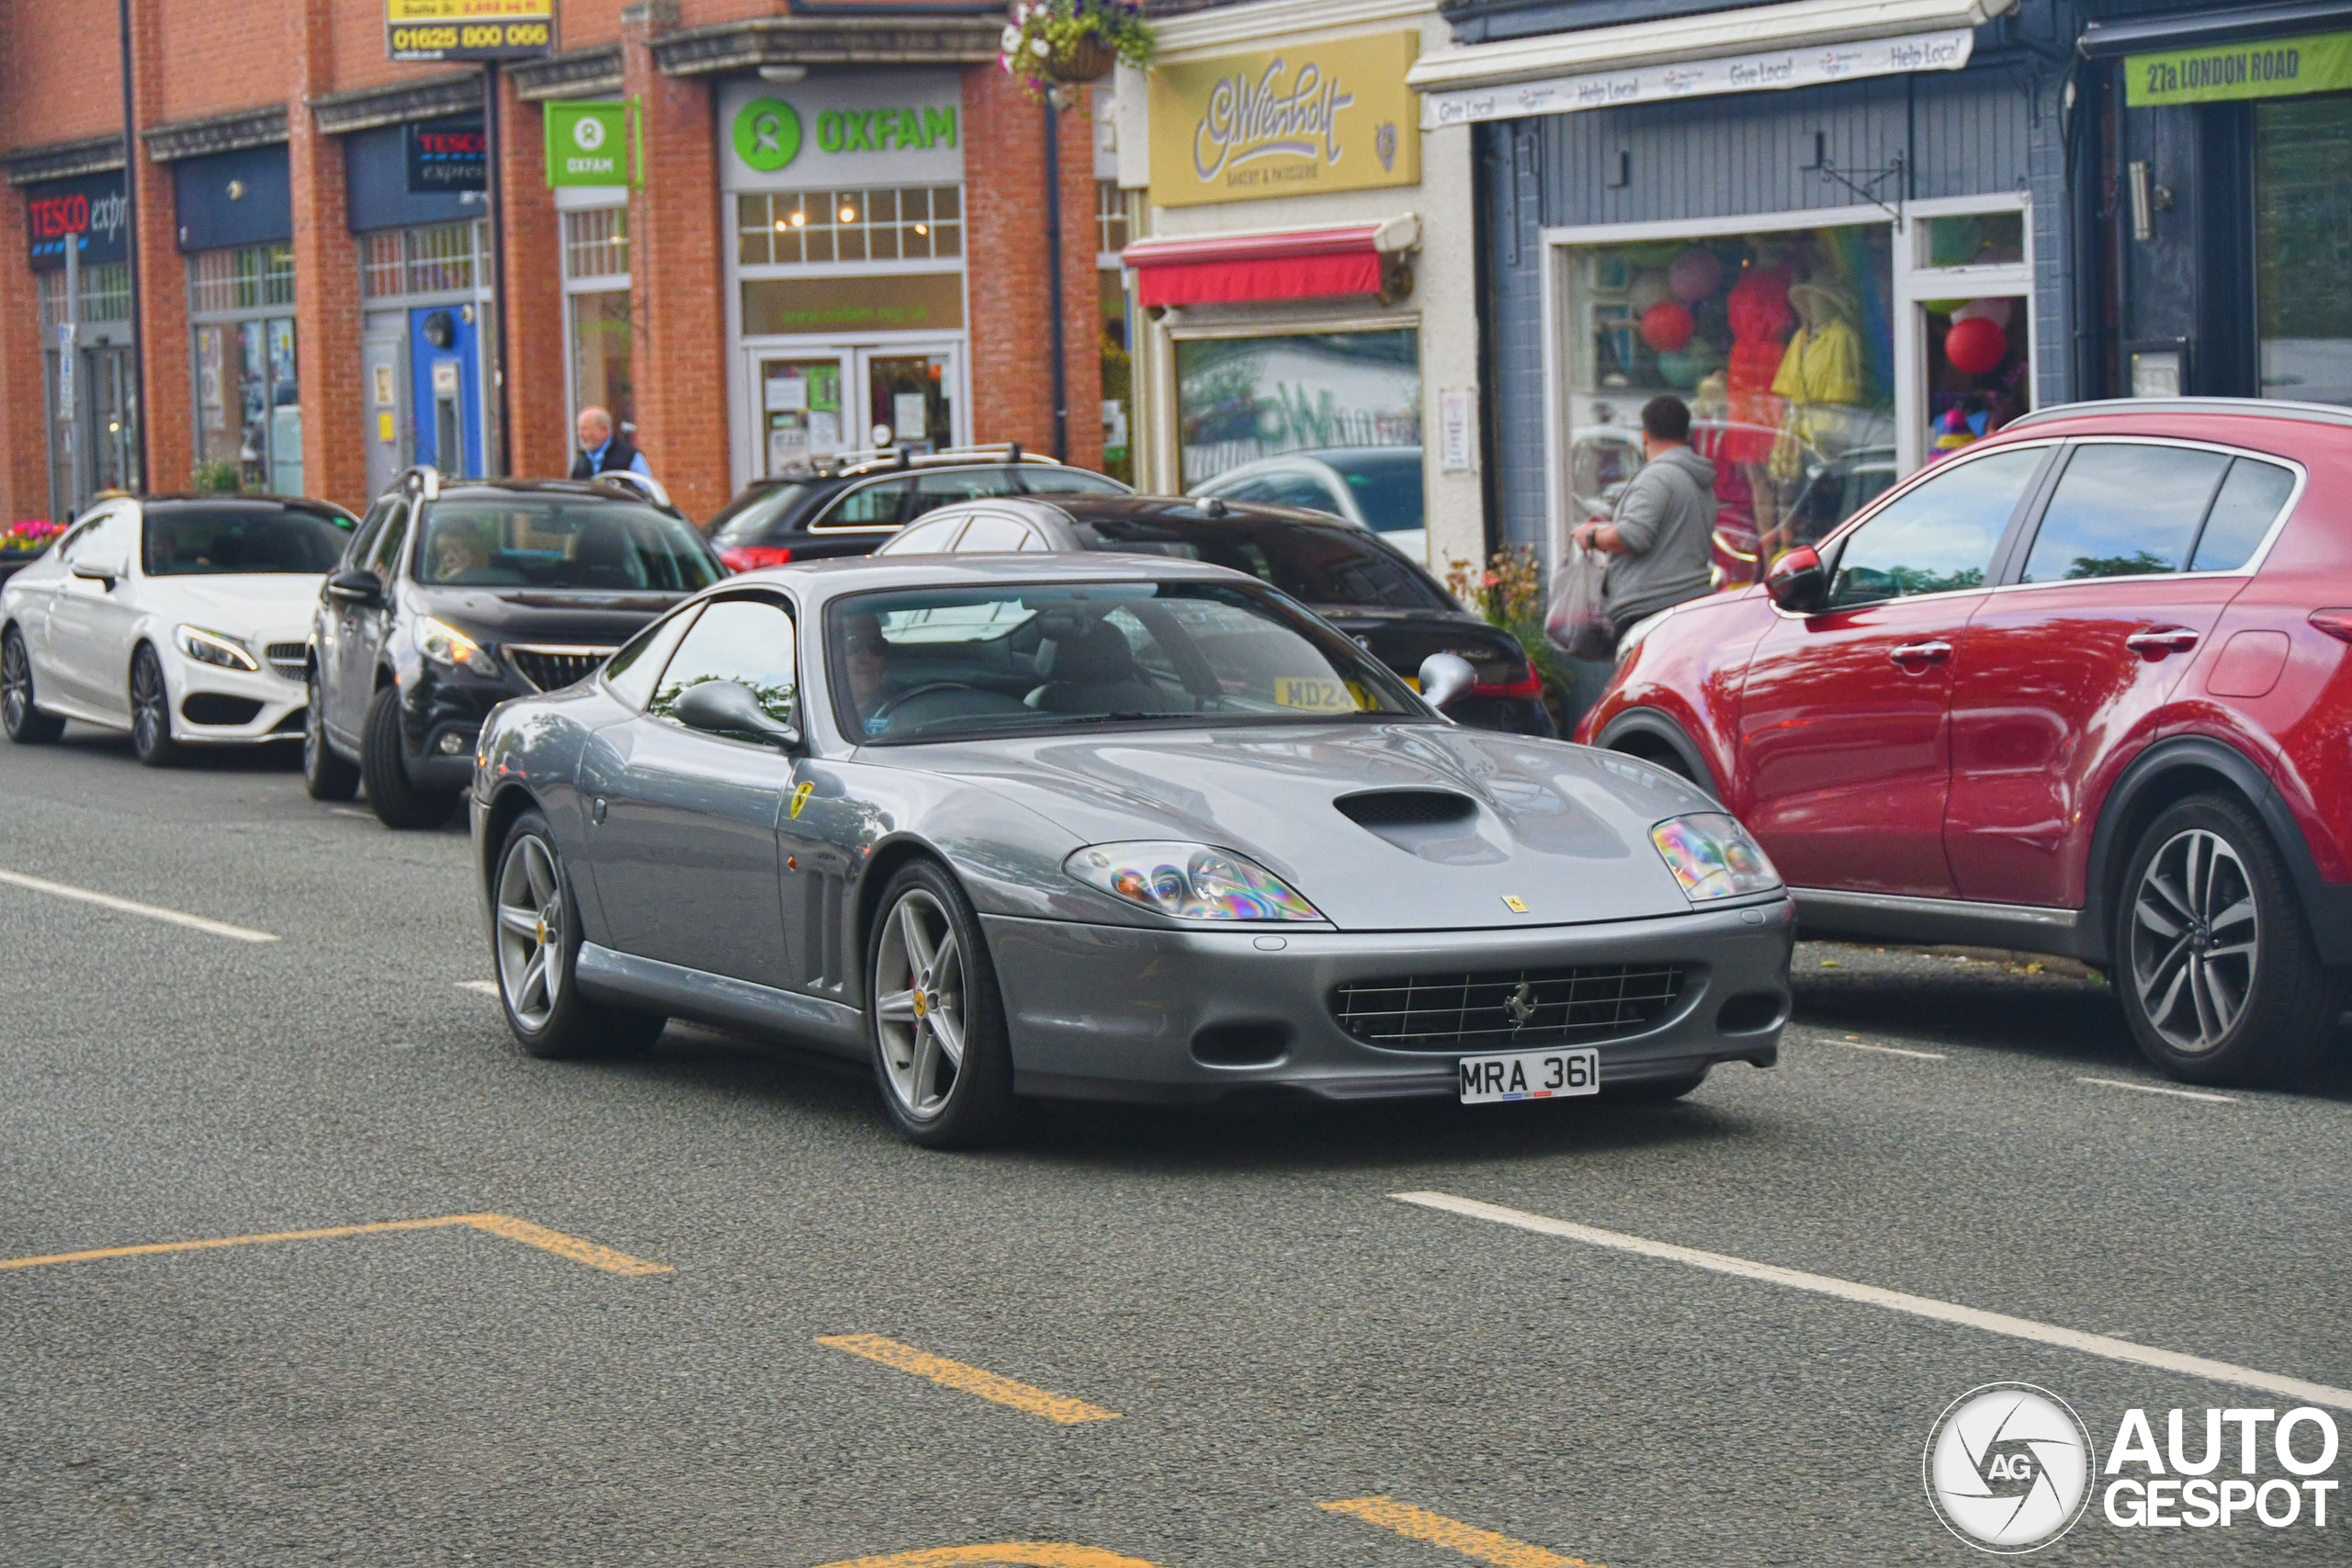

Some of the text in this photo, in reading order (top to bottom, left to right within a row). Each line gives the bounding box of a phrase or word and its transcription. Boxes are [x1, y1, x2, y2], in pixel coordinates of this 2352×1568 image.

[393, 24, 548, 50] 01625 800 066
[1891, 44, 1923, 69] Help
[1925, 38, 1962, 63] Local
[1759, 56, 1794, 81] Local
[2147, 48, 2300, 94] 27a LONDON ROAD
[816, 106, 956, 152] OXFAM
[567, 157, 614, 173] OXFAM
[30, 191, 129, 243] TESCO expr
[1461, 1055, 1595, 1095] MRA 361
